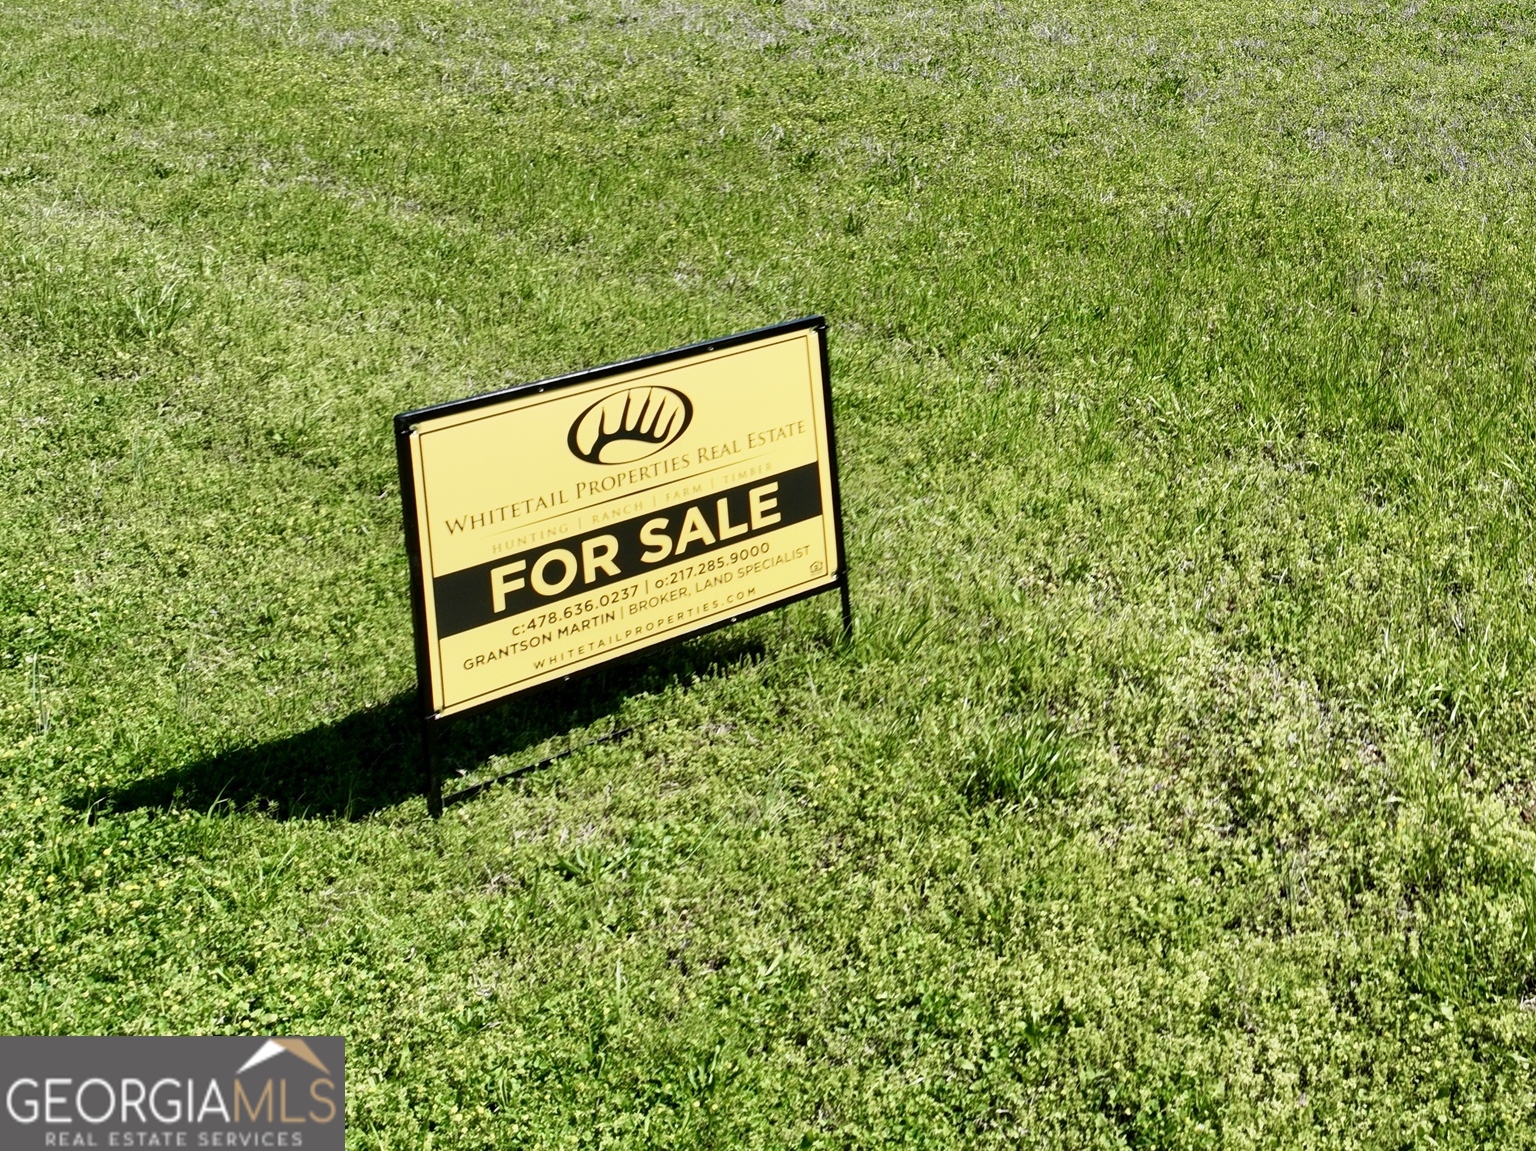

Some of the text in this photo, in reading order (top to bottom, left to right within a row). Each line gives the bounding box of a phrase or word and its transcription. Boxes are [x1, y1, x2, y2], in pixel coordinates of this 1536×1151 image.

[445, 419, 806, 536] WHITETAIL PROPERTIES REAL ESTATE
[492, 462, 773, 554] HUNTING RANCH FARM TIMBER
[490, 481, 782, 614] FOR SALE
[511, 541, 770, 637] c:478.636.0237 o:217.285.9000
[463, 545, 810, 671] GRANTSON MARTIN BROKER, LAND SPECIALIST
[533, 587, 757, 670] WHITETAILPROPERTIES.COM
